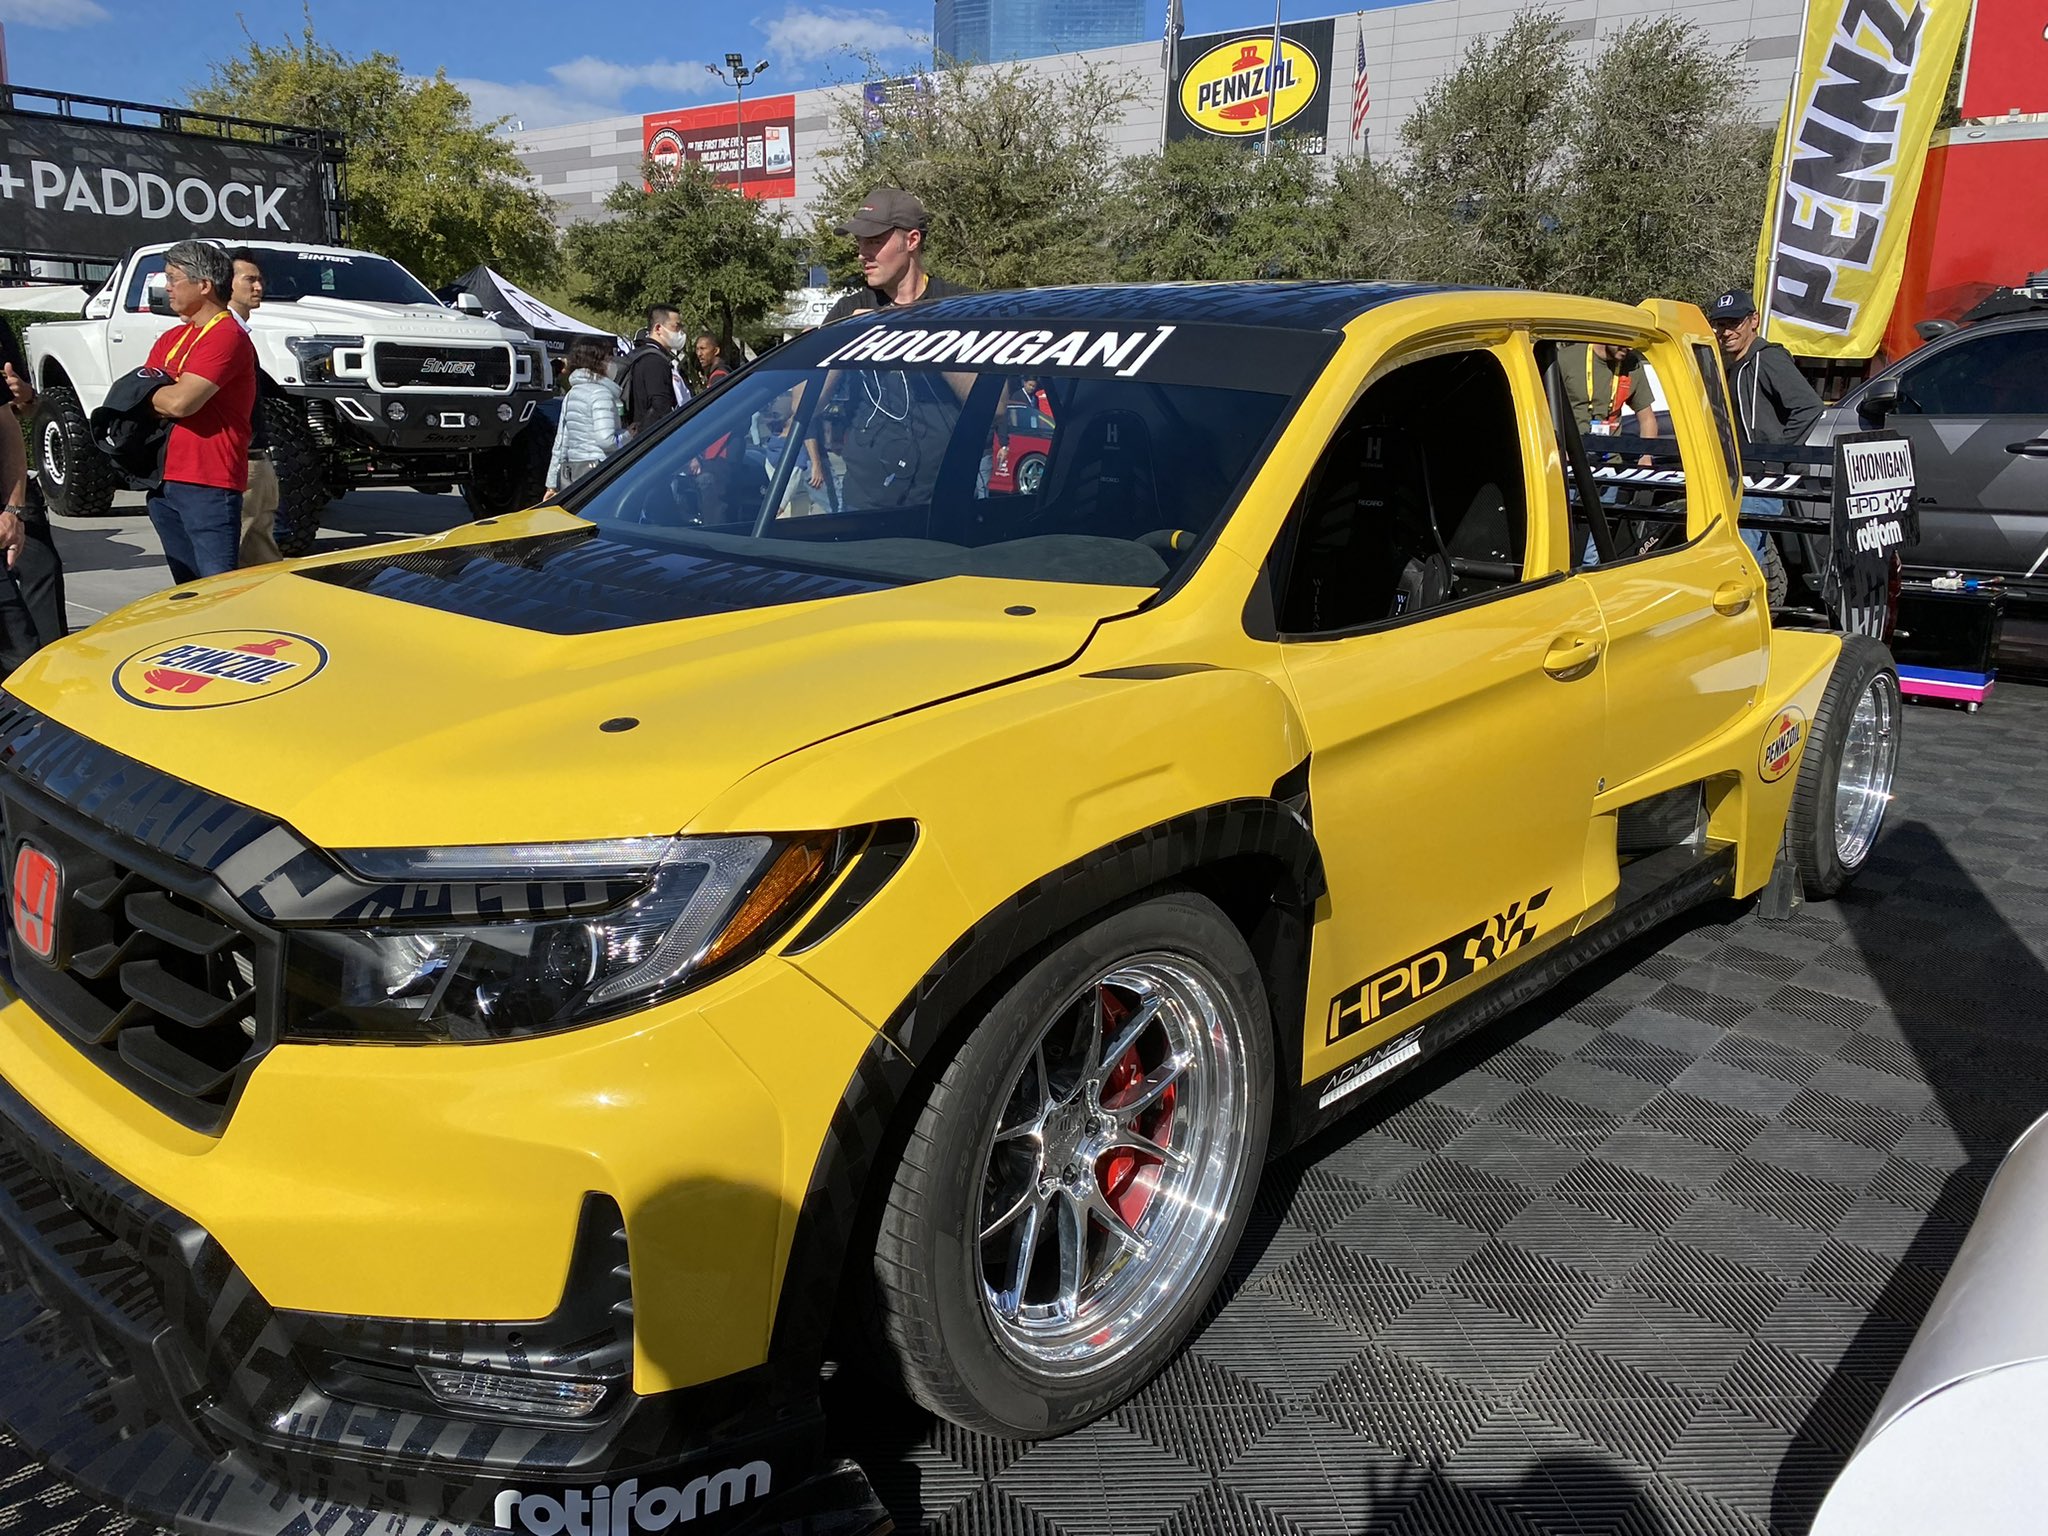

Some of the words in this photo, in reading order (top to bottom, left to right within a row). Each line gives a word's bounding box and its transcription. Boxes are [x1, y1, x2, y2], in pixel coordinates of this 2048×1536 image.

[1849, 497, 1881, 516] HPD
[1856, 517, 1903, 559] rotiform
[139, 644, 299, 685] PENNZOIL
[1763, 721, 1801, 768] PENNZOIL
[1329, 950, 1448, 1040] HPD
[494, 1460, 772, 1536] rotiform
